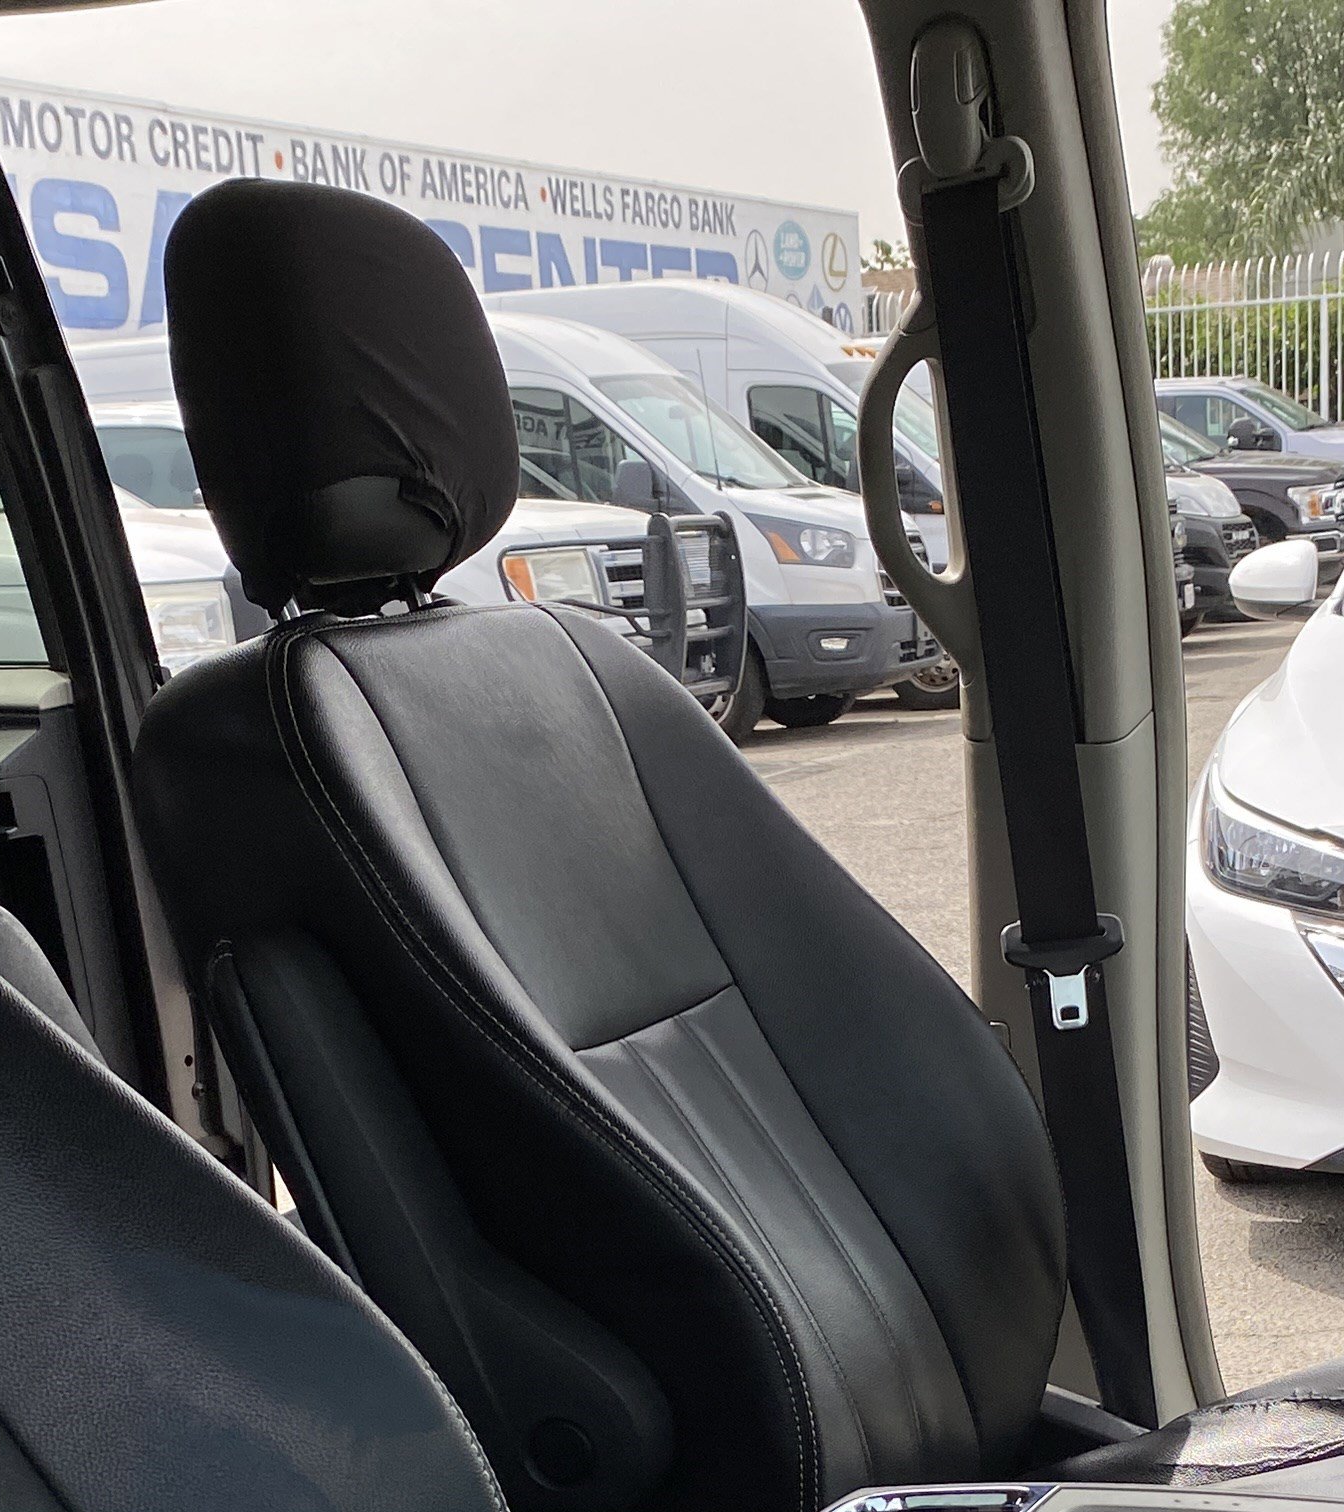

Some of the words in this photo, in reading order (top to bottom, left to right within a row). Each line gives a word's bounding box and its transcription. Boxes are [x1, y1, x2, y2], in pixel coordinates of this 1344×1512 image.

[148, 117, 265, 178] CREDIT
[290, 139, 370, 191] BANK
[379, 151, 412, 196] OF
[421, 158, 530, 212] AMERICA
[547, 176, 615, 222] WELLS
[620, 188, 683, 230] FARGO
[689, 198, 737, 237] BANK
